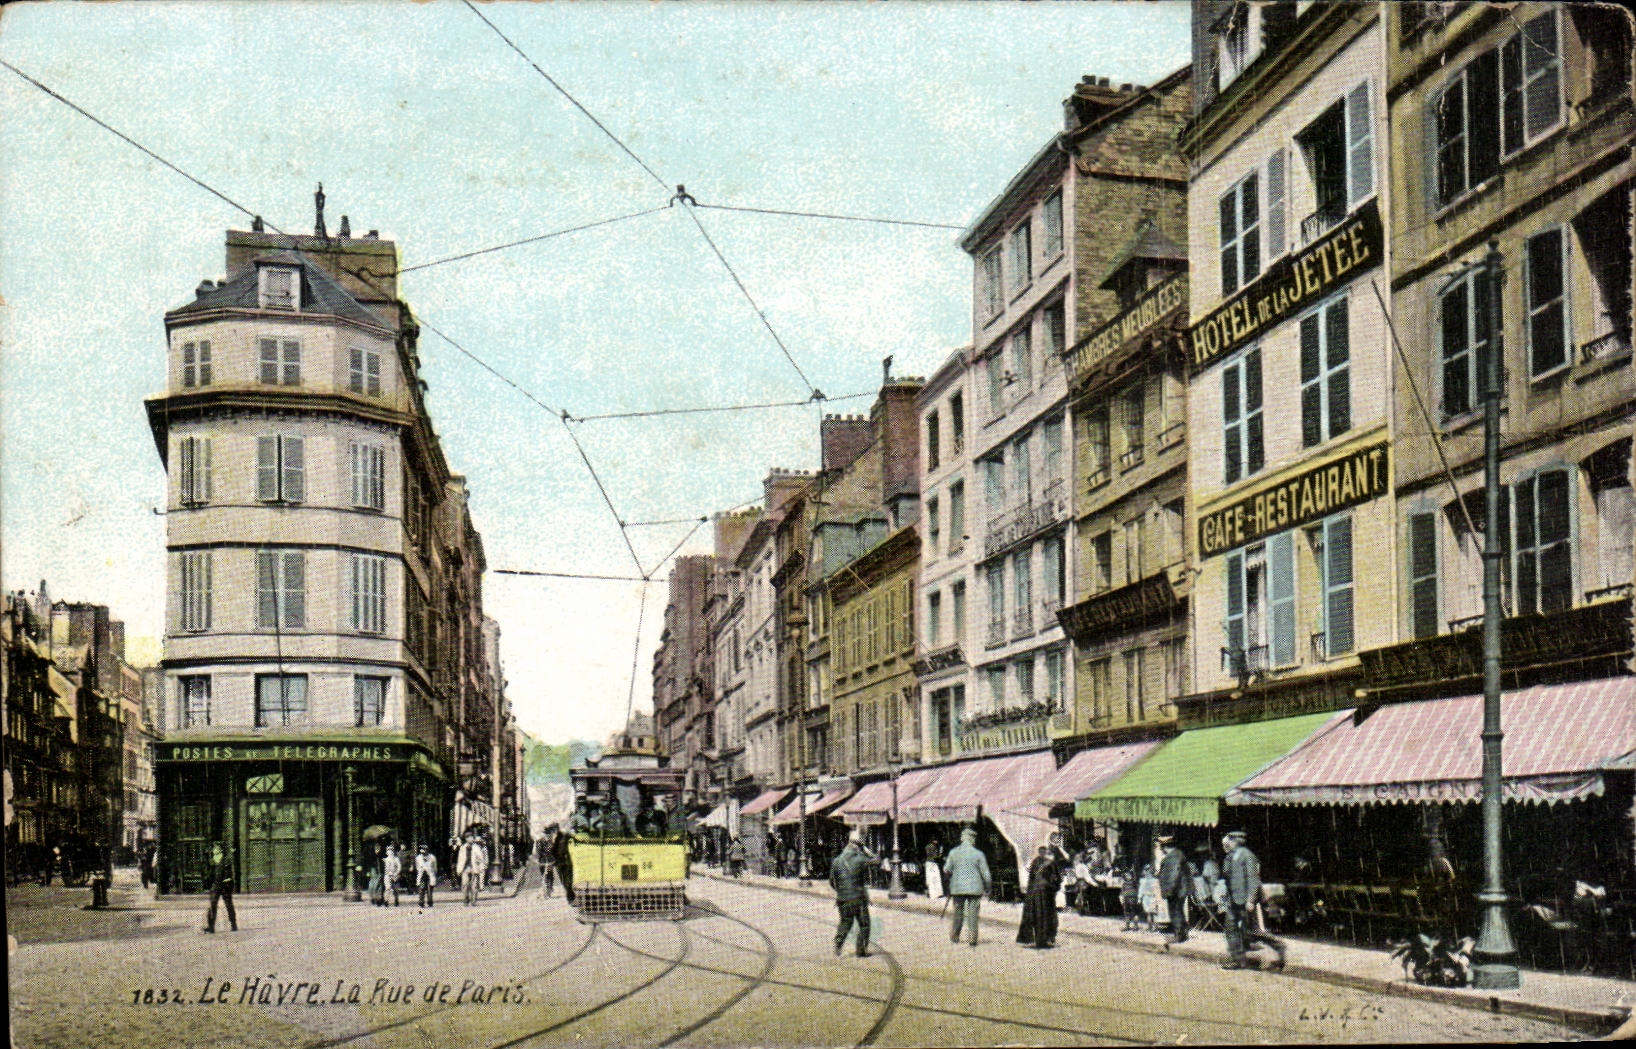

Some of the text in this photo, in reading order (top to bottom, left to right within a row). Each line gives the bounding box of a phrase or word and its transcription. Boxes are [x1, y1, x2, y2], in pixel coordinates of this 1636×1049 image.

[1064, 323, 1120, 379] CHAMBRES
[1192, 295, 1258, 364] HOTEL
[1257, 296, 1273, 323] DE
[1273, 287, 1291, 315] LA
[173, 746, 233, 760] POSTES
[273, 745, 392, 760] TELEGRAPHES
